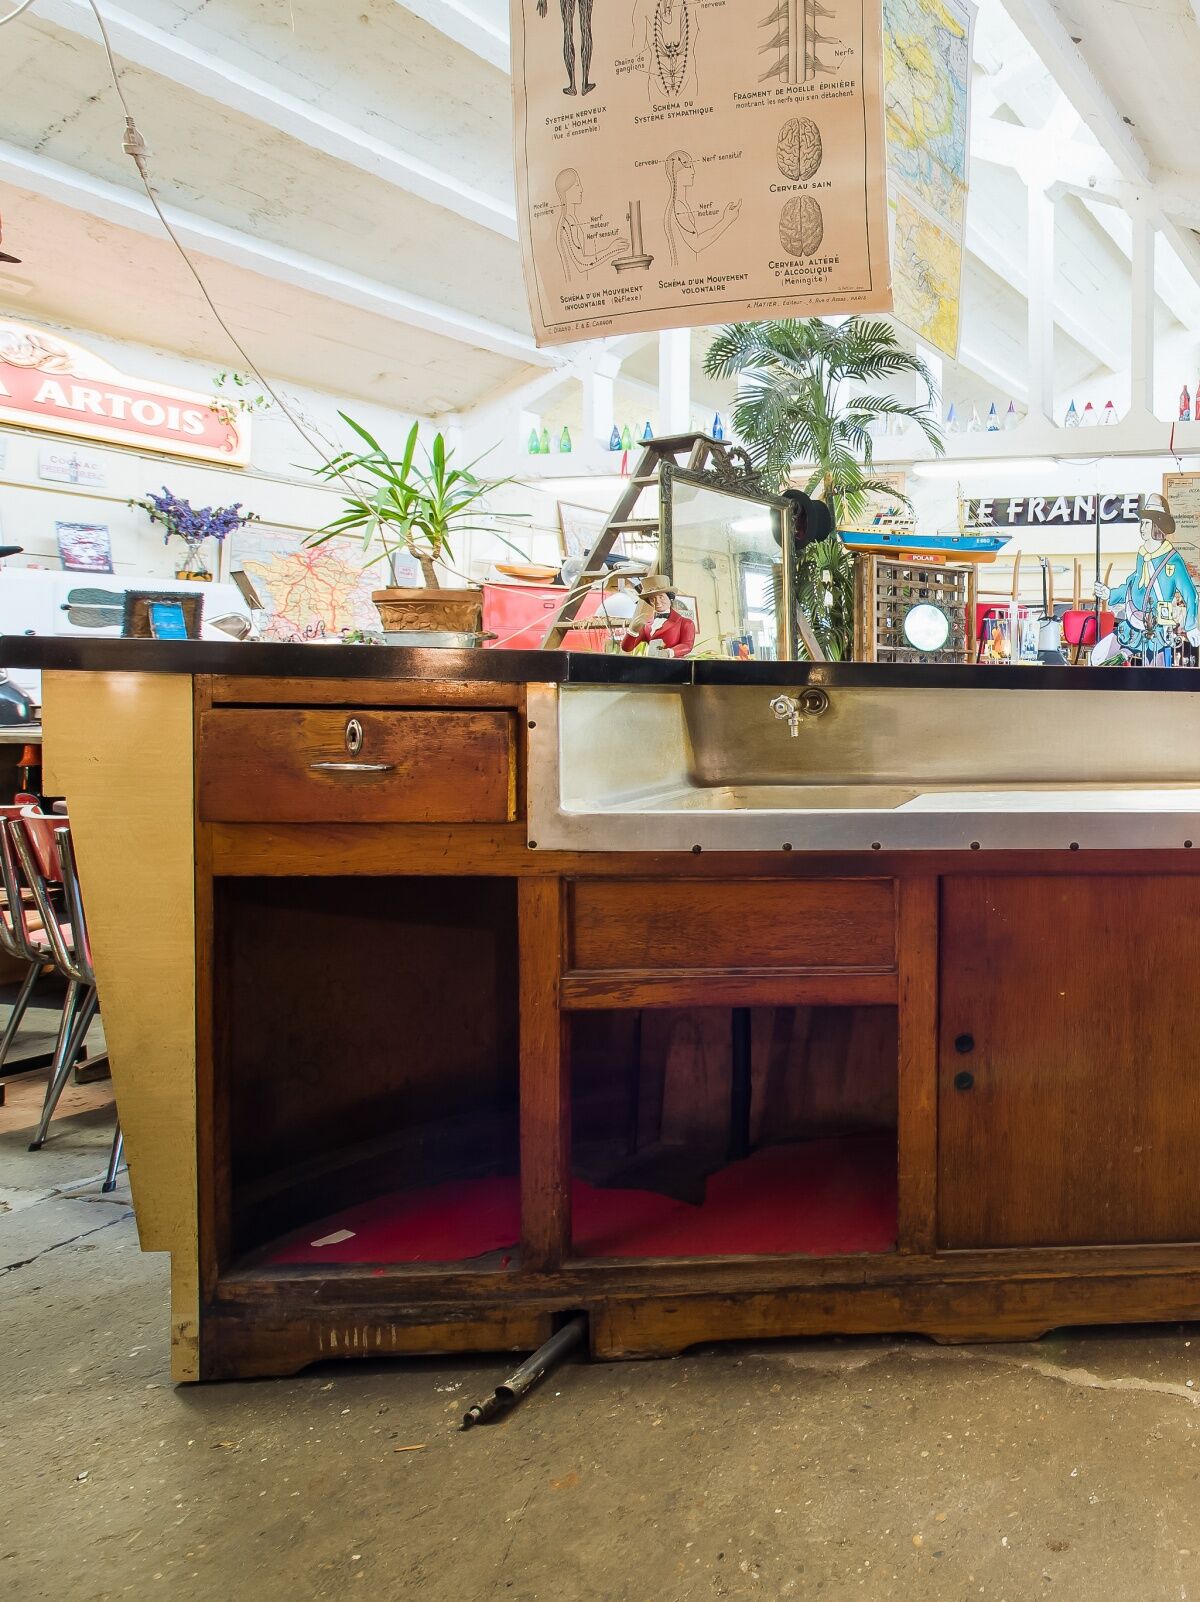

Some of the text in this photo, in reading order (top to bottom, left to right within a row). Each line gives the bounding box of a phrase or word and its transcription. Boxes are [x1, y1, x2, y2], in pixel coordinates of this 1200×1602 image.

[834, 48, 854, 57] Nerfs
[615, 63, 645, 75] ganglions
[733, 80, 856, 101] FRAGMENT DE MOELLE ÉPINIÈRE
[735, 100, 765, 109] montrant
[777, 96, 793, 104] nerfs
[794, 96, 805, 104] qui
[820, 90, 854, 99] détachent
[652, 100, 694, 113] SCHÉMA DU
[545, 105, 607, 126] SYSTÈME NERVEUX
[634, 106, 714, 125] SYSTÈME SYMPATHIQUE
[702, 151, 743, 163] Nerf sensitif
[634, 159, 659, 168] Cerveau
[769, 181, 832, 193] CERVEAU SAIN
[699, 202, 713, 210] Nerf
[590, 214, 603, 223] Nerf
[697, 209, 720, 217] moteur
[589, 221, 610, 230] moteur
[586, 229, 620, 240] Nerf sensitif
[768, 254, 840, 269] CERVEAU ALTÉRÉ
[658, 273, 749, 289] SCHÉMA D'UN MOUVEMENT
[560, 294, 584, 304] SCHÉMA
[602, 285, 643, 297] MOUVEMENT
[681, 284, 726, 294] VOLONTAIRE
[564, 294, 642, 311] INVOLONTAIRE (Réflexe)
[33, 378, 205, 436] ARTOIS
[1007, 493, 1141, 523] FRANCE
